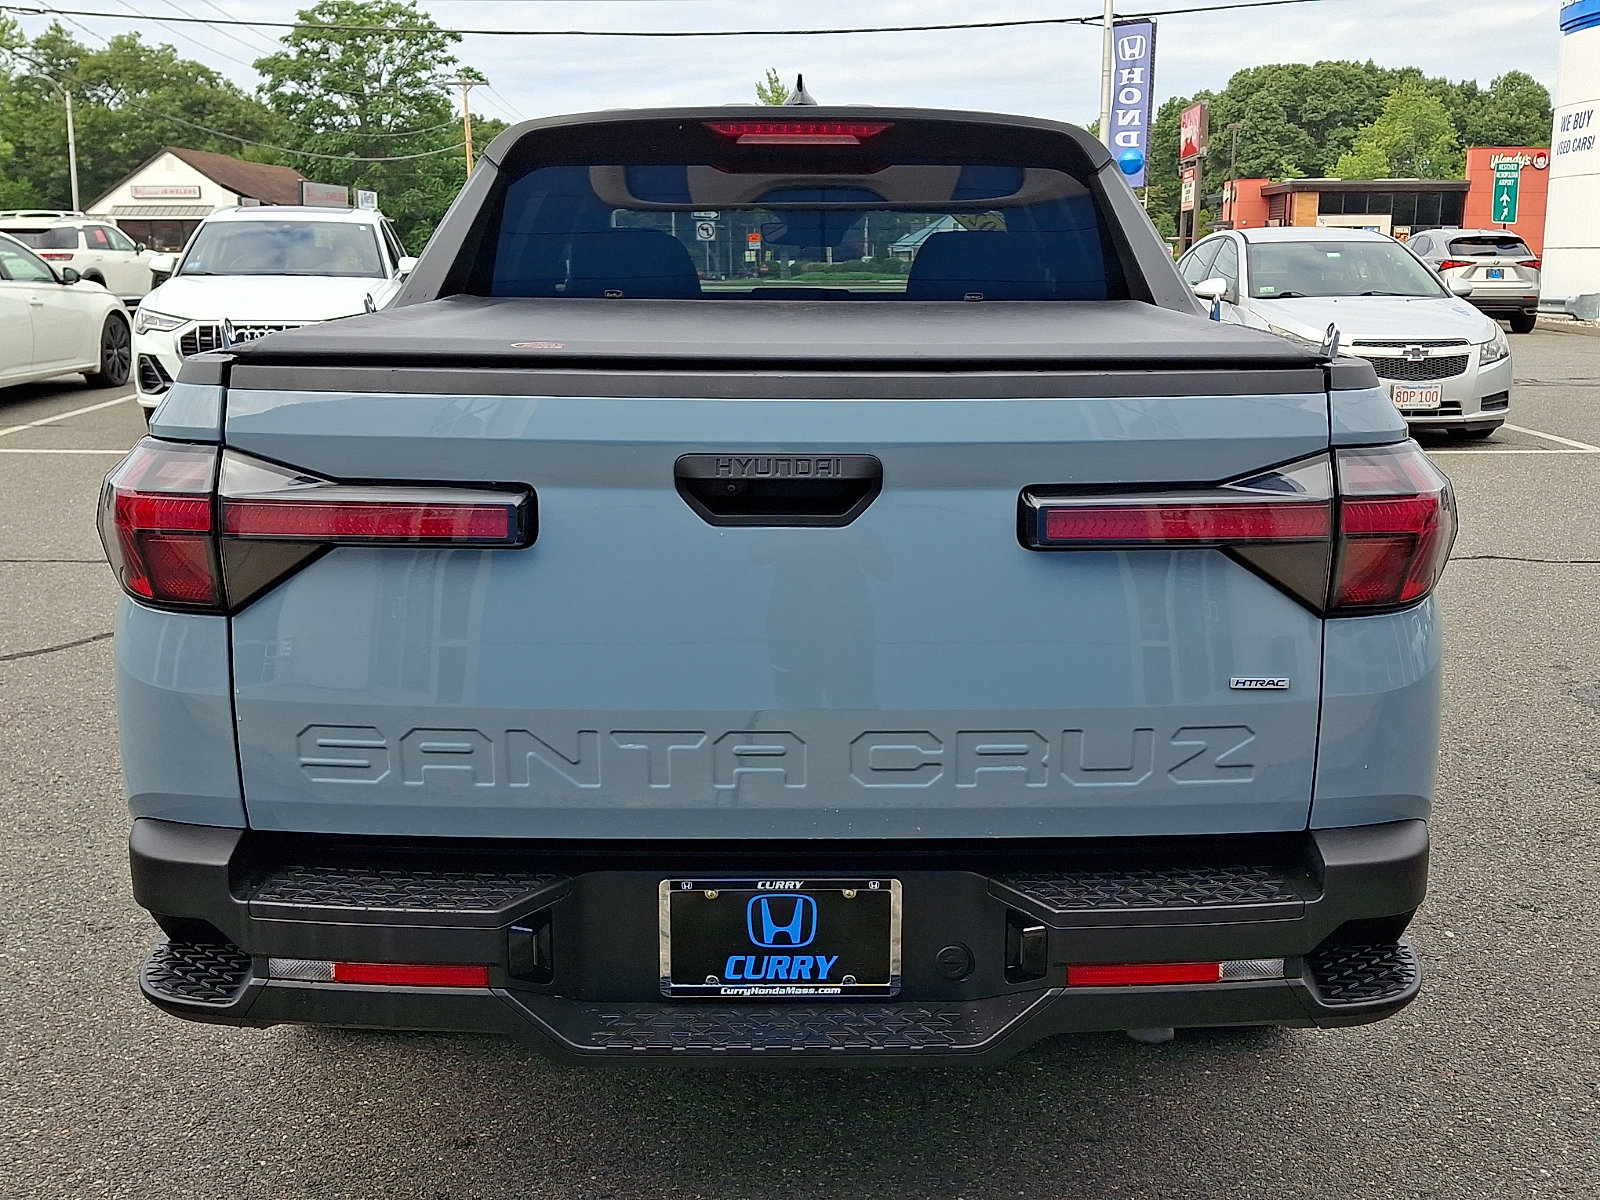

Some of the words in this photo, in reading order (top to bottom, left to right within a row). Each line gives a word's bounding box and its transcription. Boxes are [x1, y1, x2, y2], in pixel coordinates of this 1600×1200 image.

[1561, 114, 1572, 132] WE
[1573, 110, 1593, 130] BUY
[1557, 140, 1571, 156] USED
[1572, 135, 1595, 152] CARS!
[1395, 390, 1416, 403] 8DP
[1418, 390, 1439, 403] 100
[715, 458, 841, 477] HYUNDAI
[1234, 679, 1286, 687] HTRAC
[297, 724, 807, 789] SANTA
[850, 725, 1256, 788] CRUZ
[757, 880, 804, 890] CURRY
[725, 955, 839, 980] CURRY
[720, 987, 842, 996] CurryHondaMass.com
